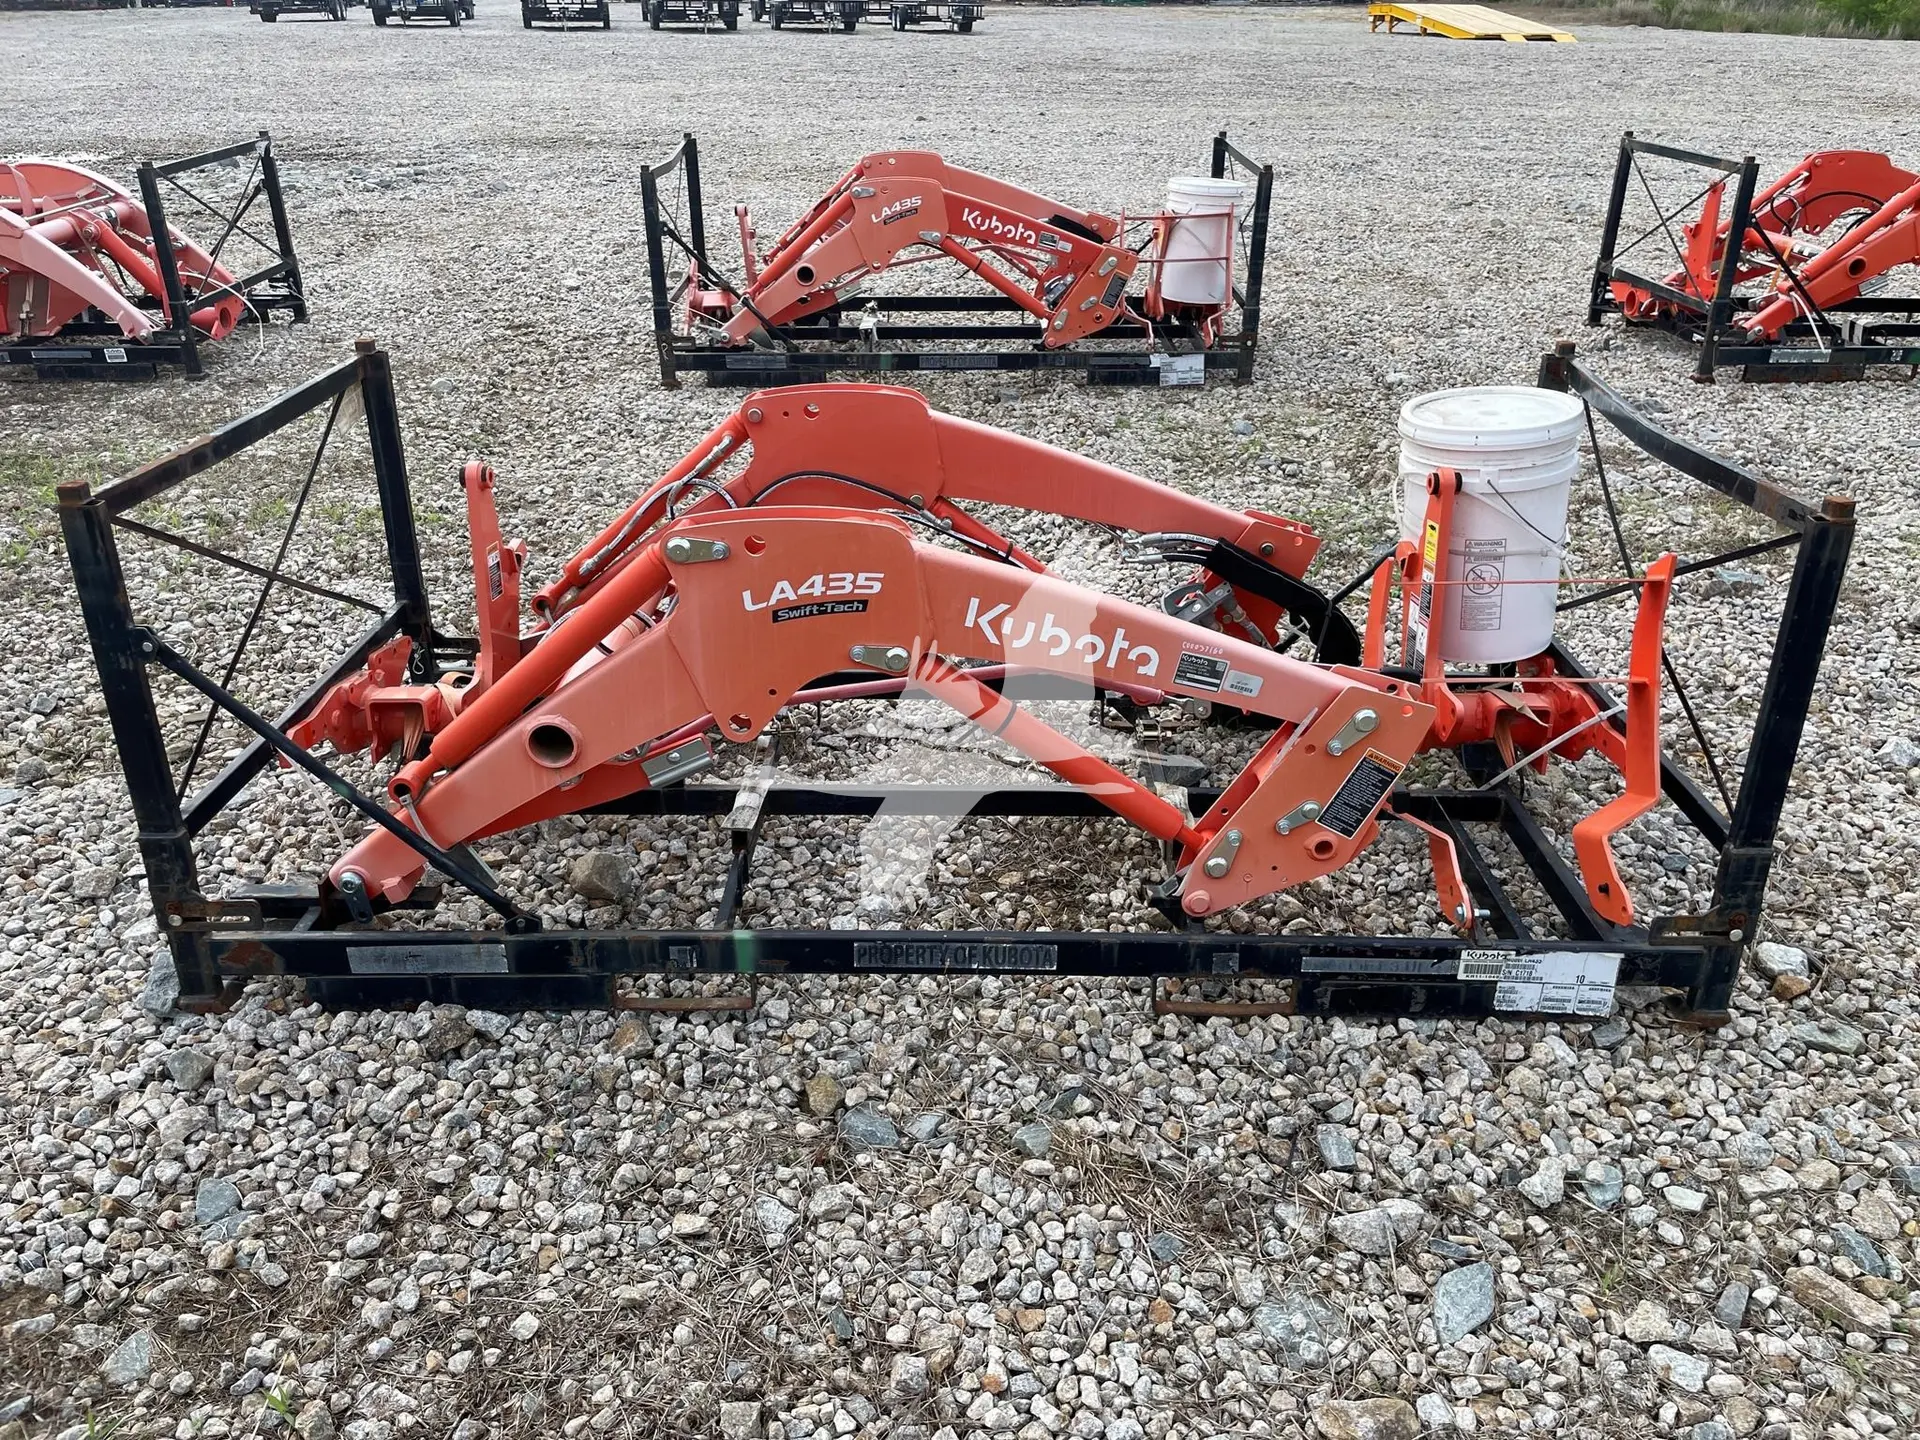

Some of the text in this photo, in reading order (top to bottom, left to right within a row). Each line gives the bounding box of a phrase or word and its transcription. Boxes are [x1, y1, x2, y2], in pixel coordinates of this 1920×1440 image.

[871, 196, 923, 223] LA435
[962, 207, 1036, 245] Kubota
[742, 572, 884, 612] LA435
[777, 602, 864, 621] Swift-Tach
[964, 597, 1160, 677] Kubota
[1182, 654, 1209, 666] Kubota
[1373, 754, 1402, 772] WARNING
[856, 944, 1055, 967] PROPERTY OF KUBOTA
[1467, 951, 1508, 960] Kubota
[1575, 974, 1586, 984] 10
